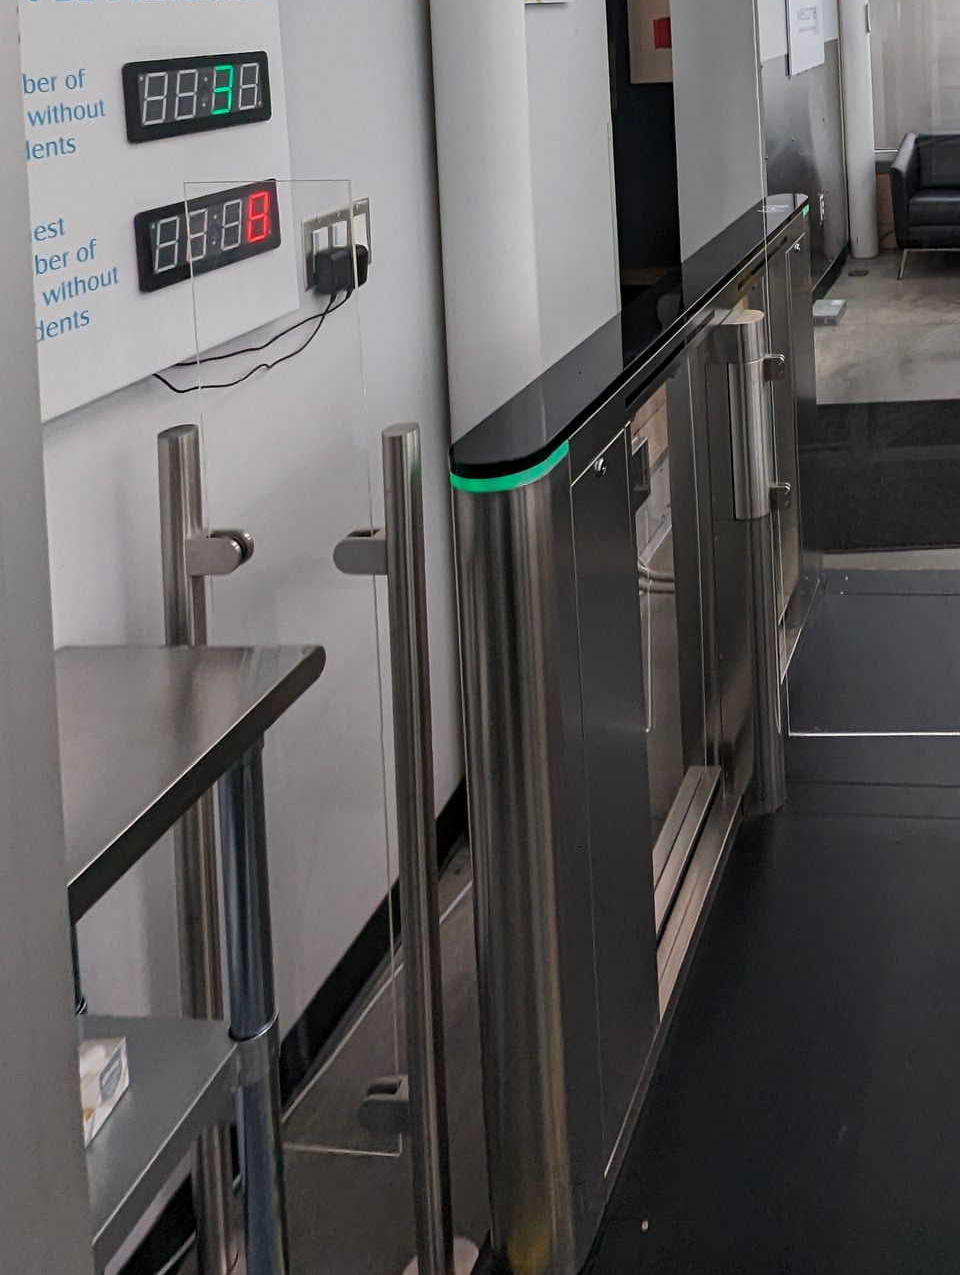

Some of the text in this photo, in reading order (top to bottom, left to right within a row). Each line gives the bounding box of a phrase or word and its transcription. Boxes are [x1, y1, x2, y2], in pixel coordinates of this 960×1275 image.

[65, 68, 86, 90] of
[27, 99, 106, 127] without
[76, 238, 97, 263] of
[42, 265, 120, 306] without
